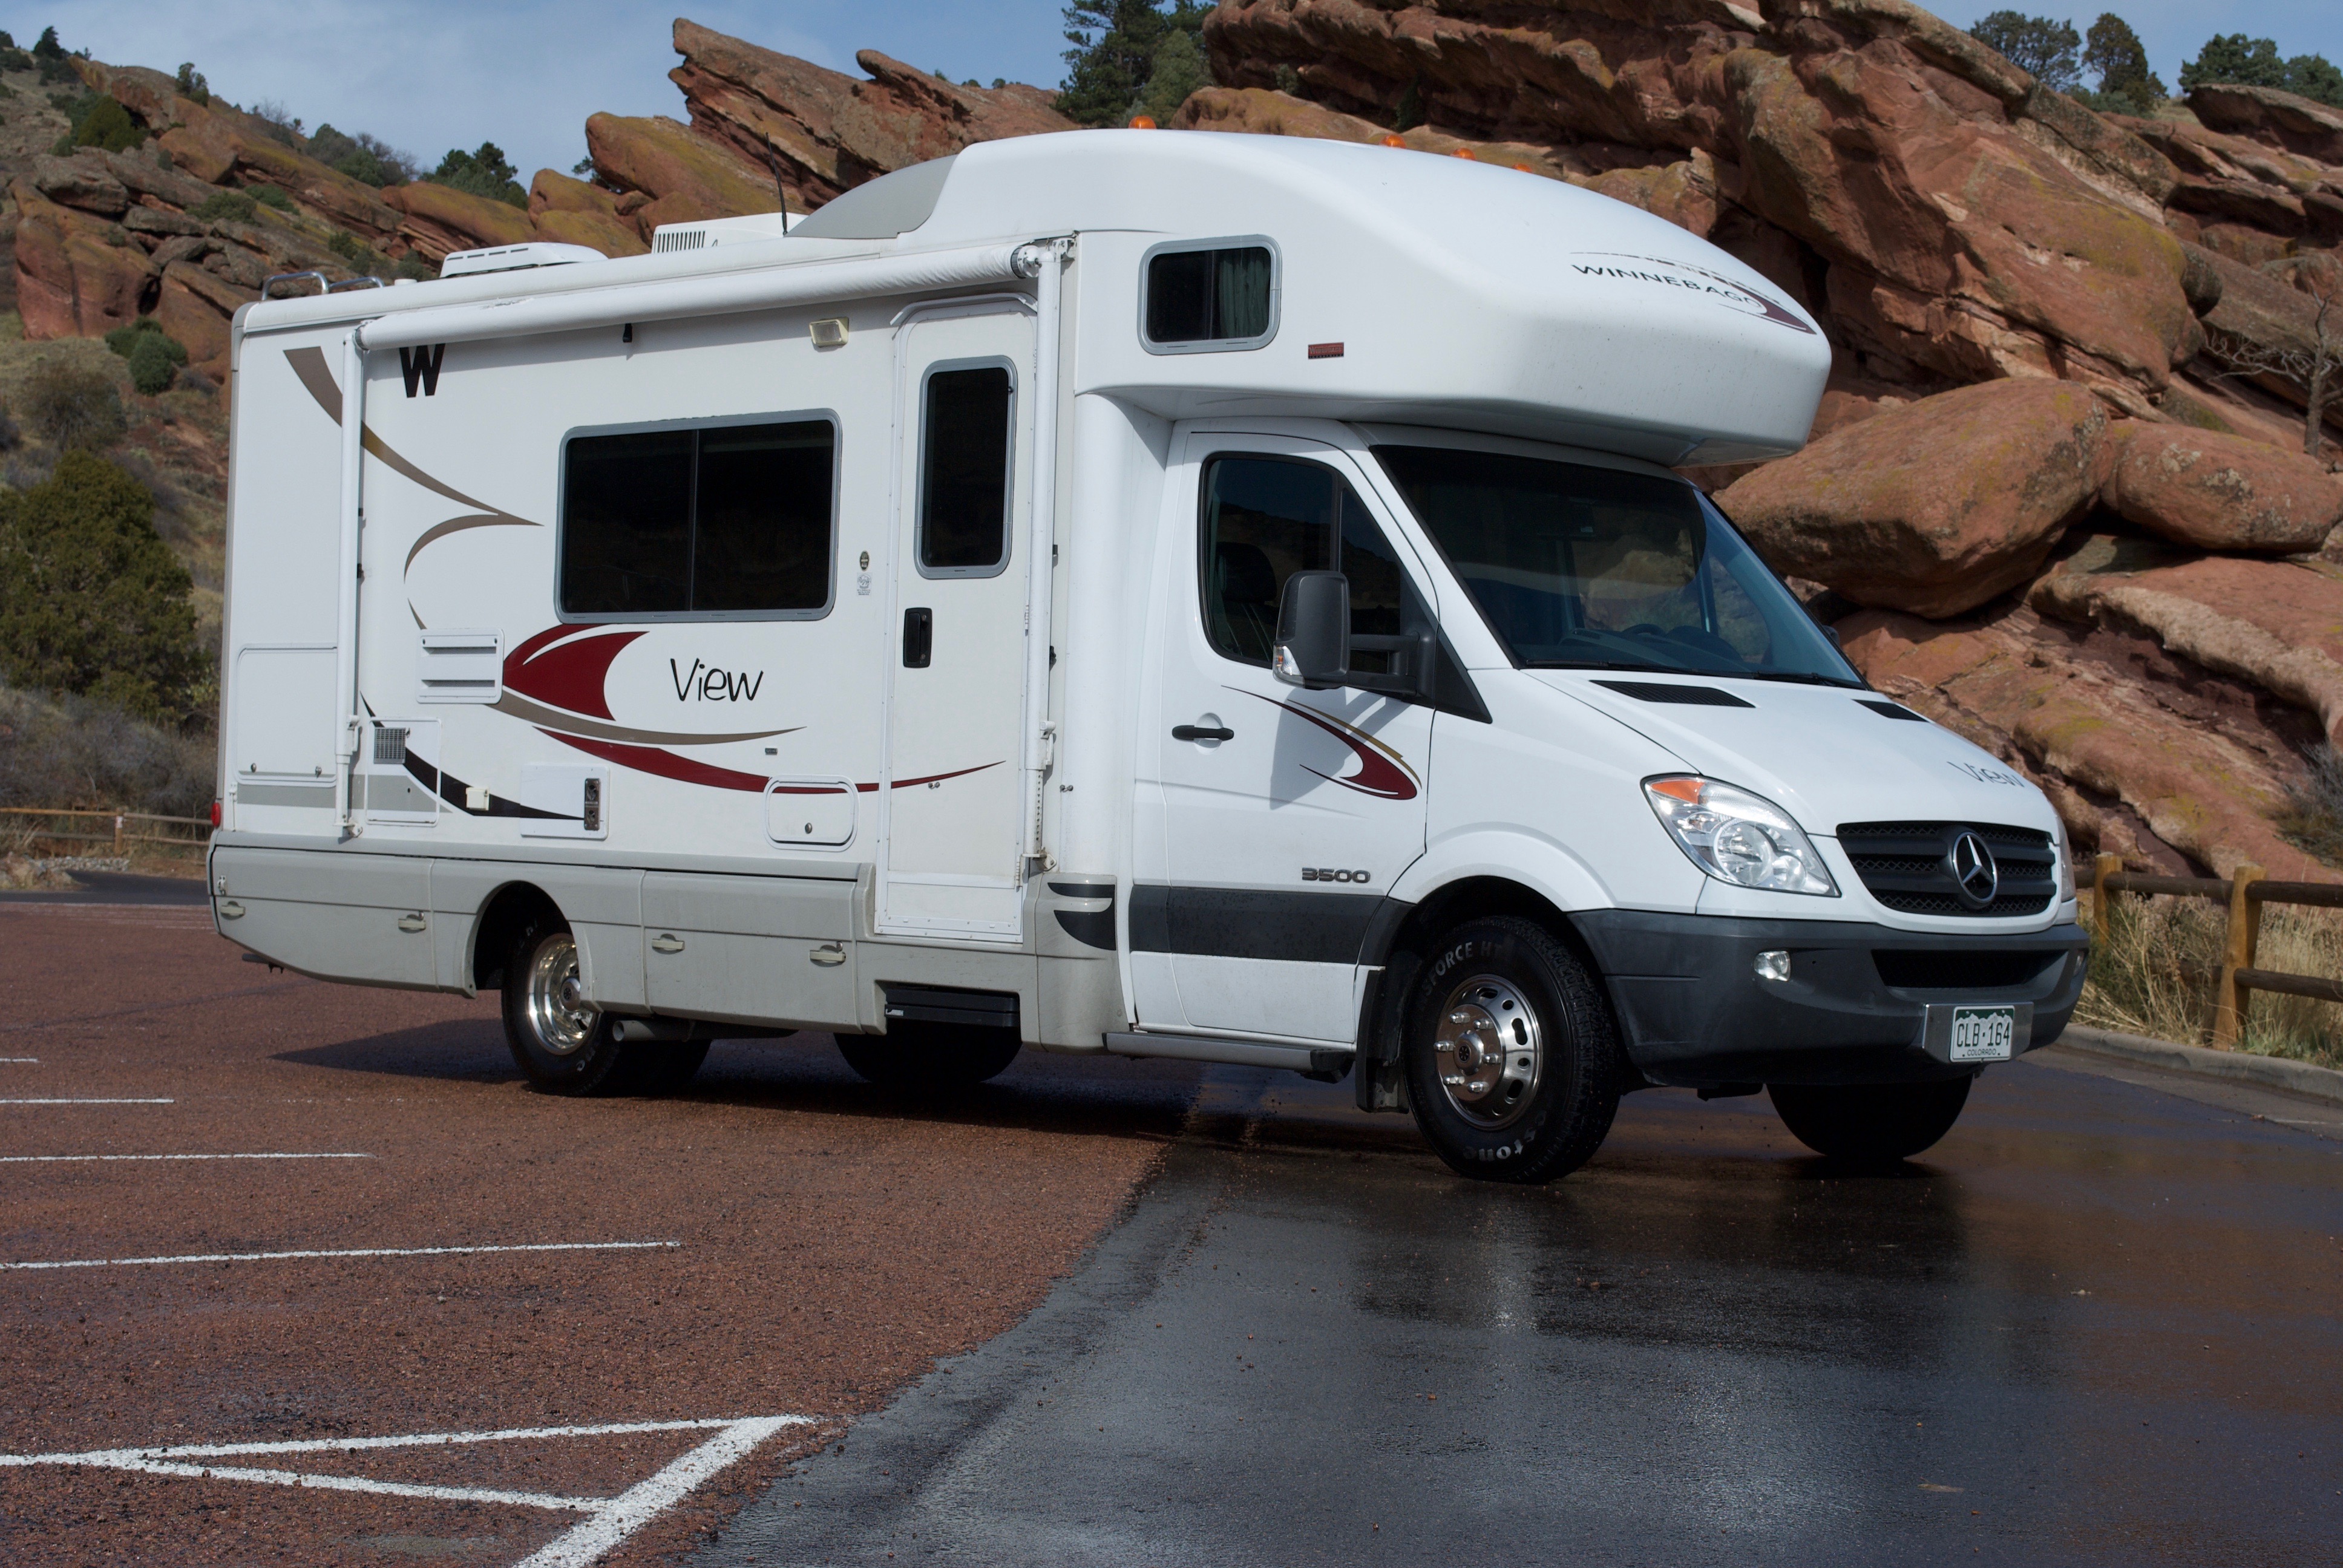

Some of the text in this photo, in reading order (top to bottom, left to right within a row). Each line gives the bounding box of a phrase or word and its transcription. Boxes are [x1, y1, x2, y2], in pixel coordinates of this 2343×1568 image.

[1571, 264, 1762, 308] WINNEBAGO
[399, 343, 446, 398] W
[670, 658, 764, 702] View
[1946, 761, 2025, 788] View
[1302, 867, 1371, 884] 3500
[1967, 1048, 1996, 1057] COLORADO
